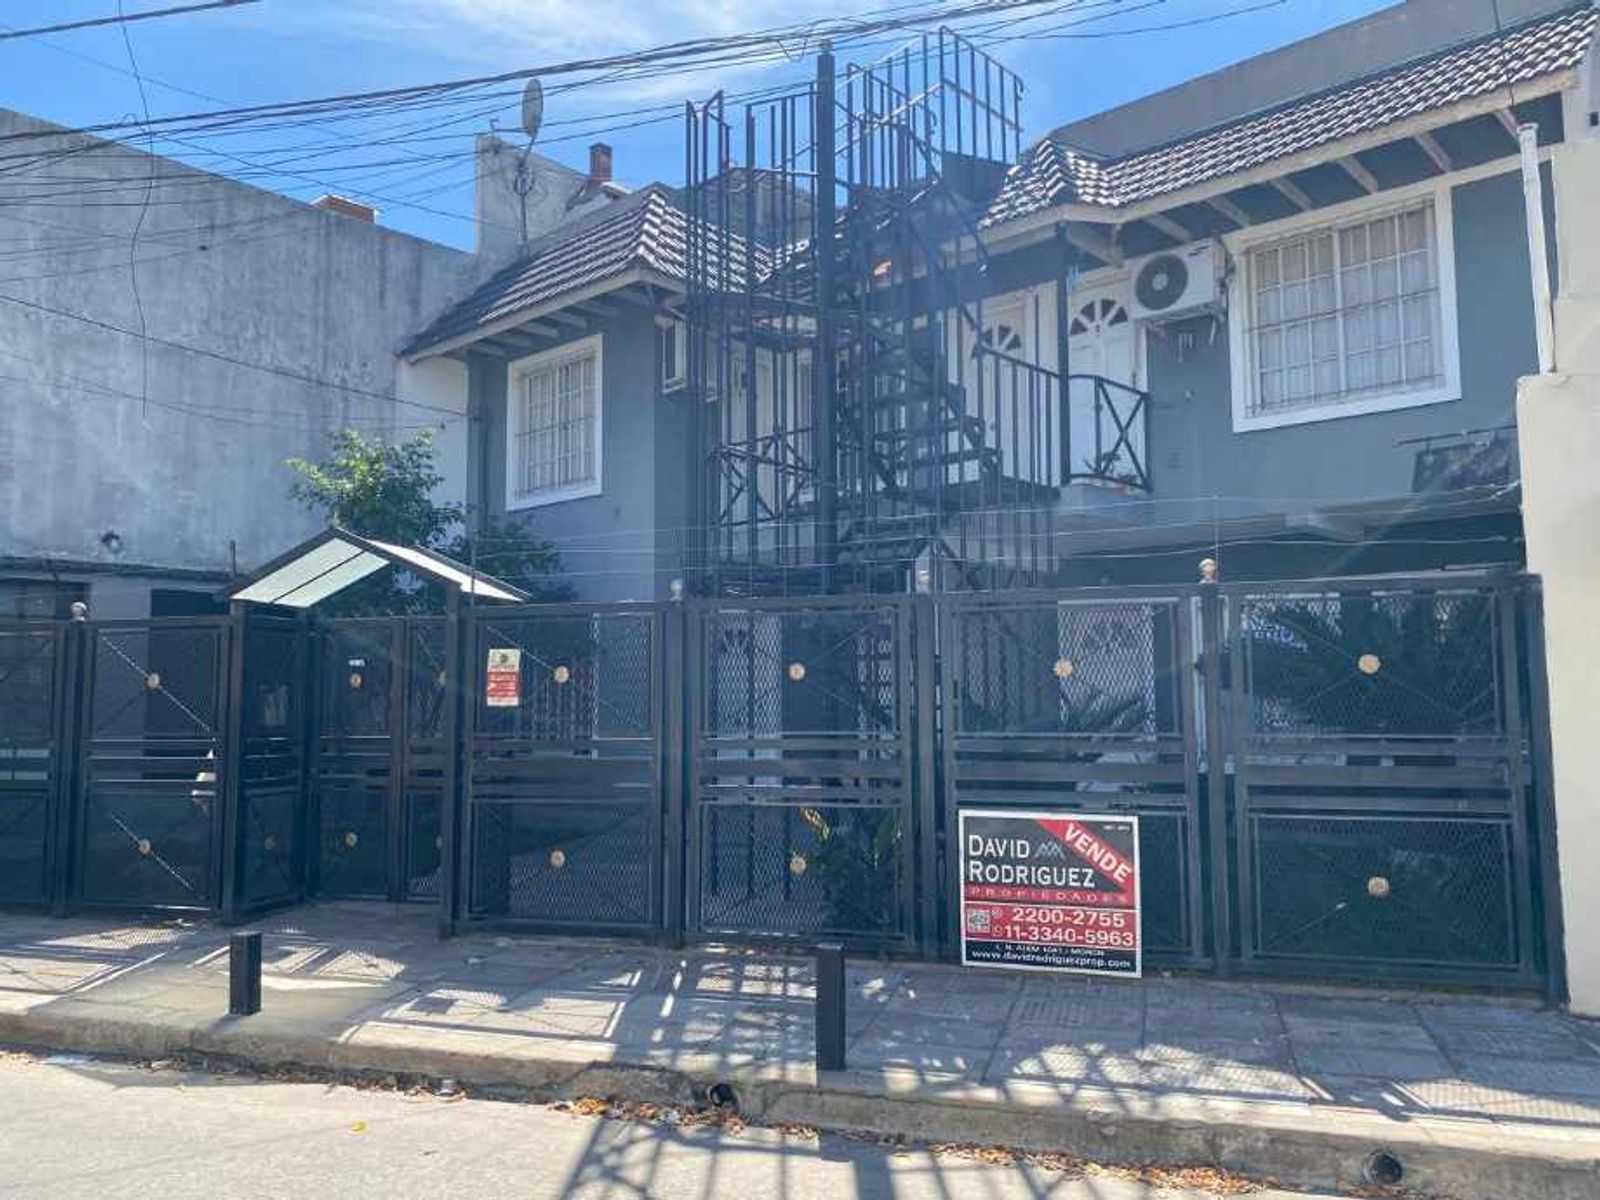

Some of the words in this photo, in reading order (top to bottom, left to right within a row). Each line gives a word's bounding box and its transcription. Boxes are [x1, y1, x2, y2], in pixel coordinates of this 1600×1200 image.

[969, 834, 1030, 858] DAVID
[1065, 822, 1131, 883] VENDE
[969, 860, 1095, 887] RODRIGUEZ
[970, 887, 1128, 903] PROPIEDADES
[1012, 907, 1125, 928] 2200-2755
[1005, 925, 1134, 947] 11-3340-5963
